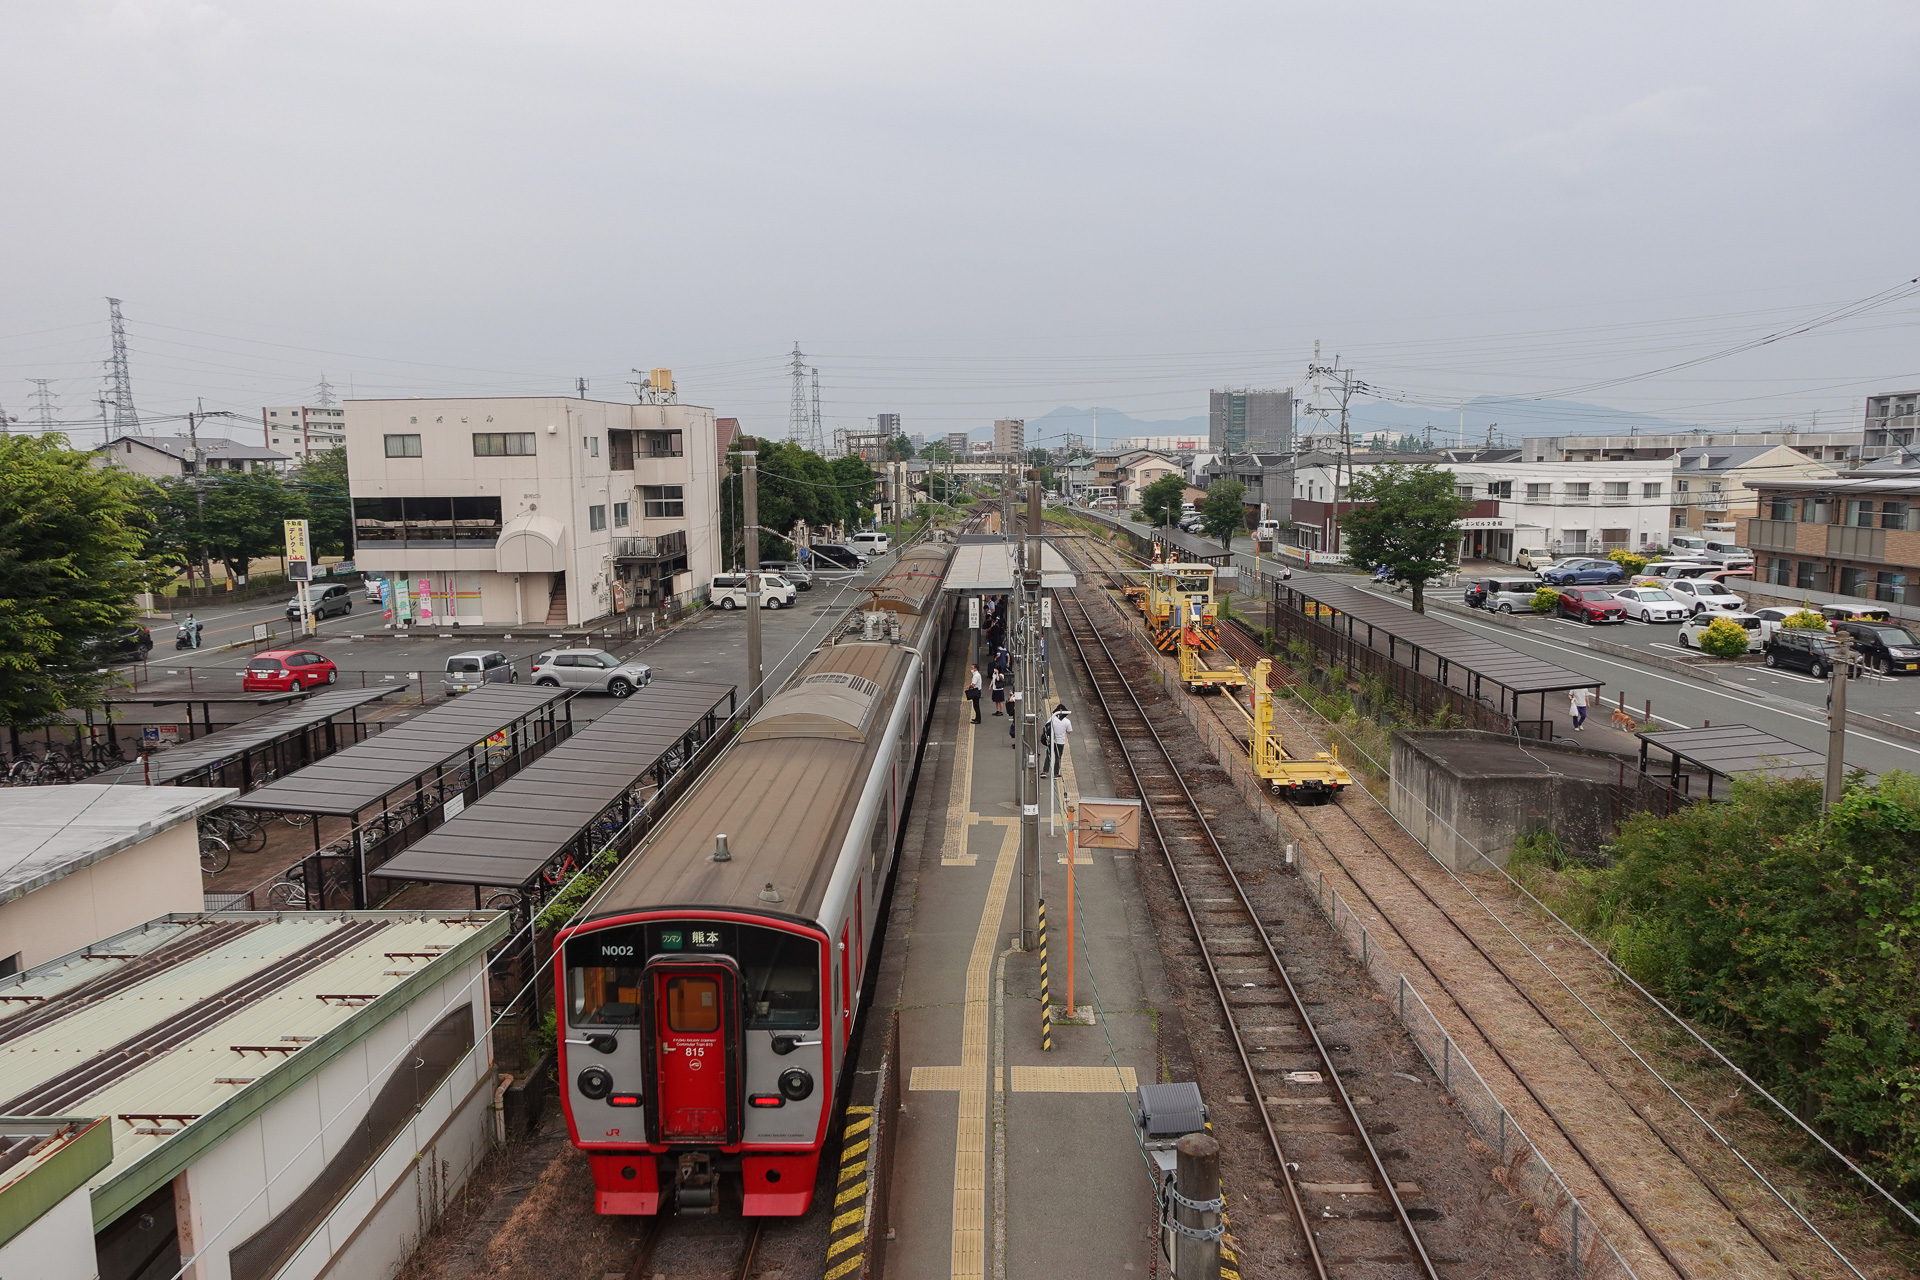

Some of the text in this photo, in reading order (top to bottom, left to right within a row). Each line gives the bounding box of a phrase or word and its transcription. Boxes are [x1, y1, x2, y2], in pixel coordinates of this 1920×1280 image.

[662, 935, 681, 943] ワンマン
[692, 931, 719, 943] 熊本
[601, 946, 634, 956] N002
[685, 1047, 705, 1057] 815
[605, 1128, 620, 1137] JR
